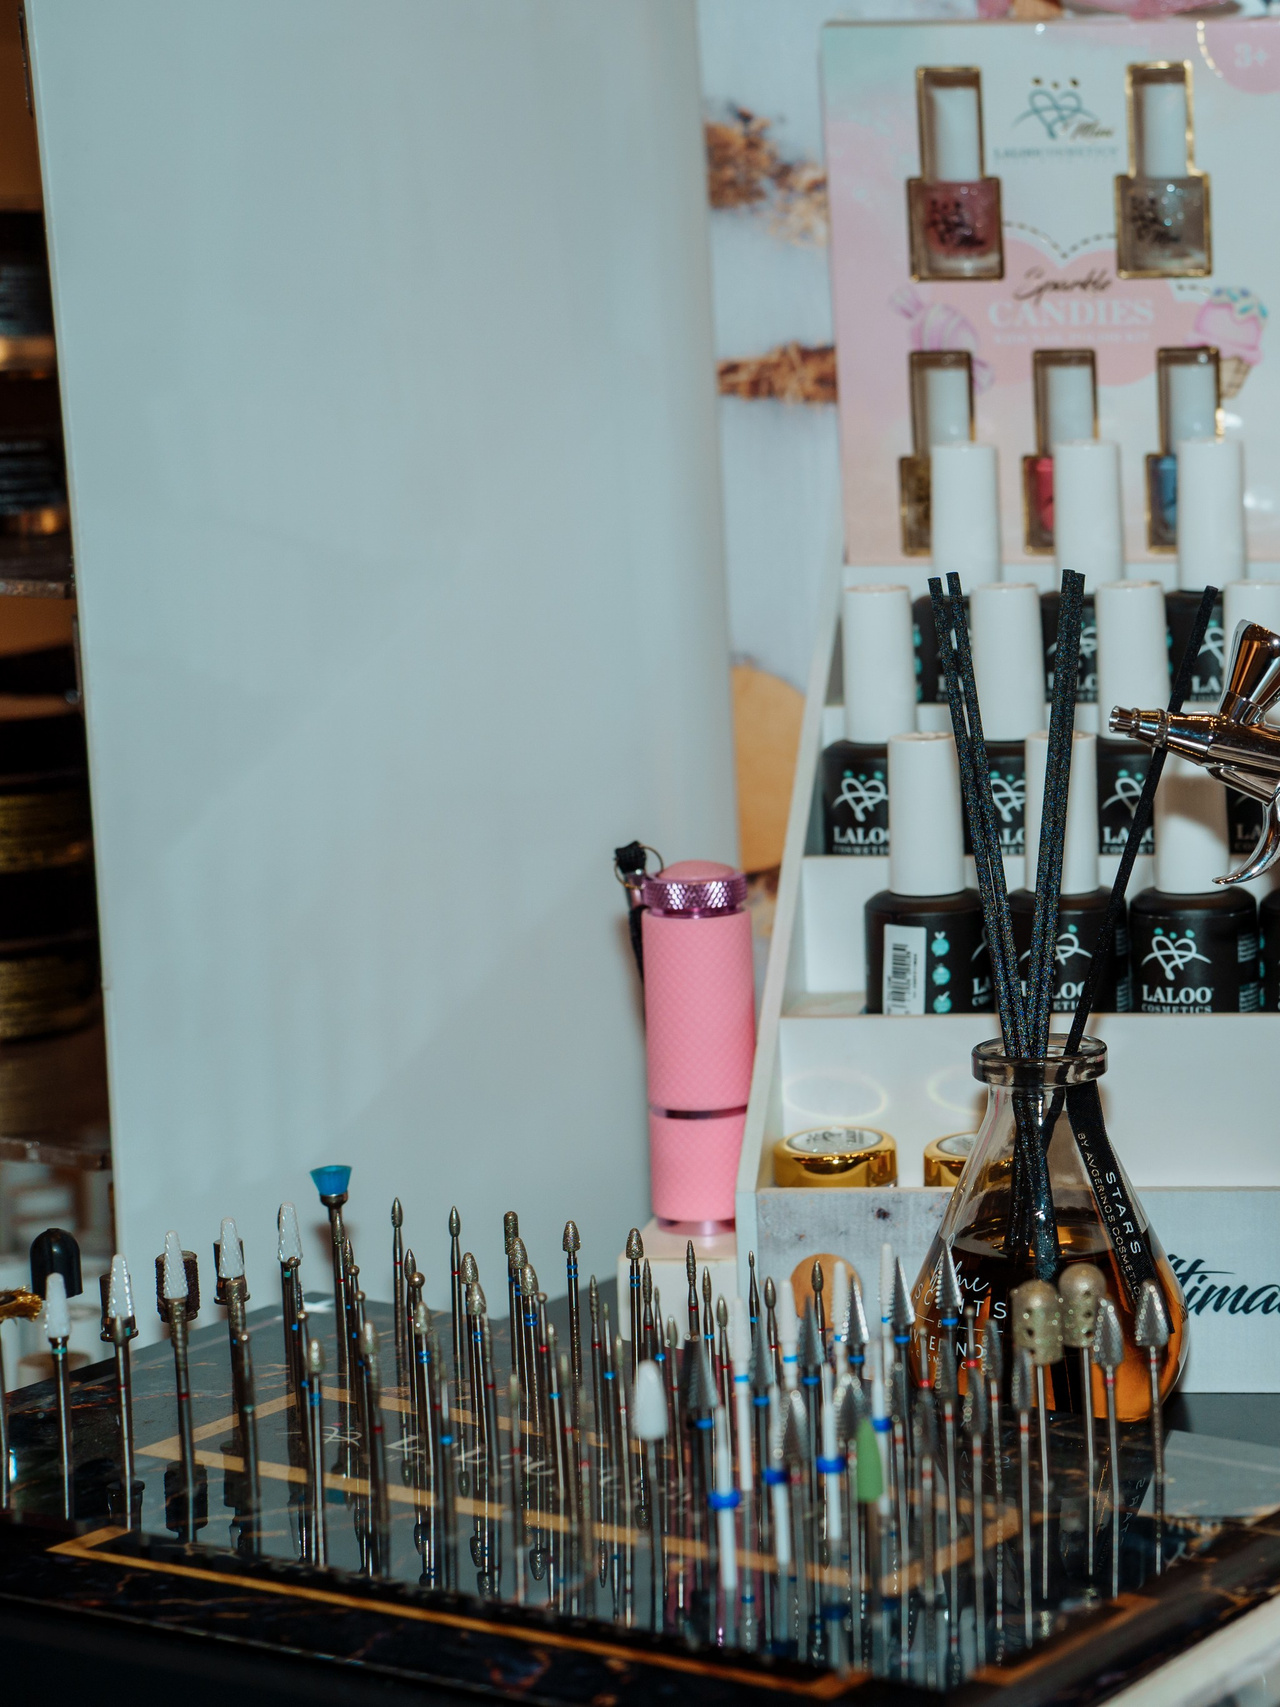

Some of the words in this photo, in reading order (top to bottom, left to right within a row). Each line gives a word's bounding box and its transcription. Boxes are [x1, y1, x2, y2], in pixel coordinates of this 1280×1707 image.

[988, 300, 1155, 328] CANDIES
[1141, 984, 1213, 1004] LALOO
[1141, 1003, 1212, 1014] COSMETICS
[1077, 1132, 1090, 1148] BY
[1085, 1151, 1116, 1223] AVGERINOS
[1112, 1227, 1142, 1296] COSMETIC
[1105, 1171, 1142, 1254] STARS
